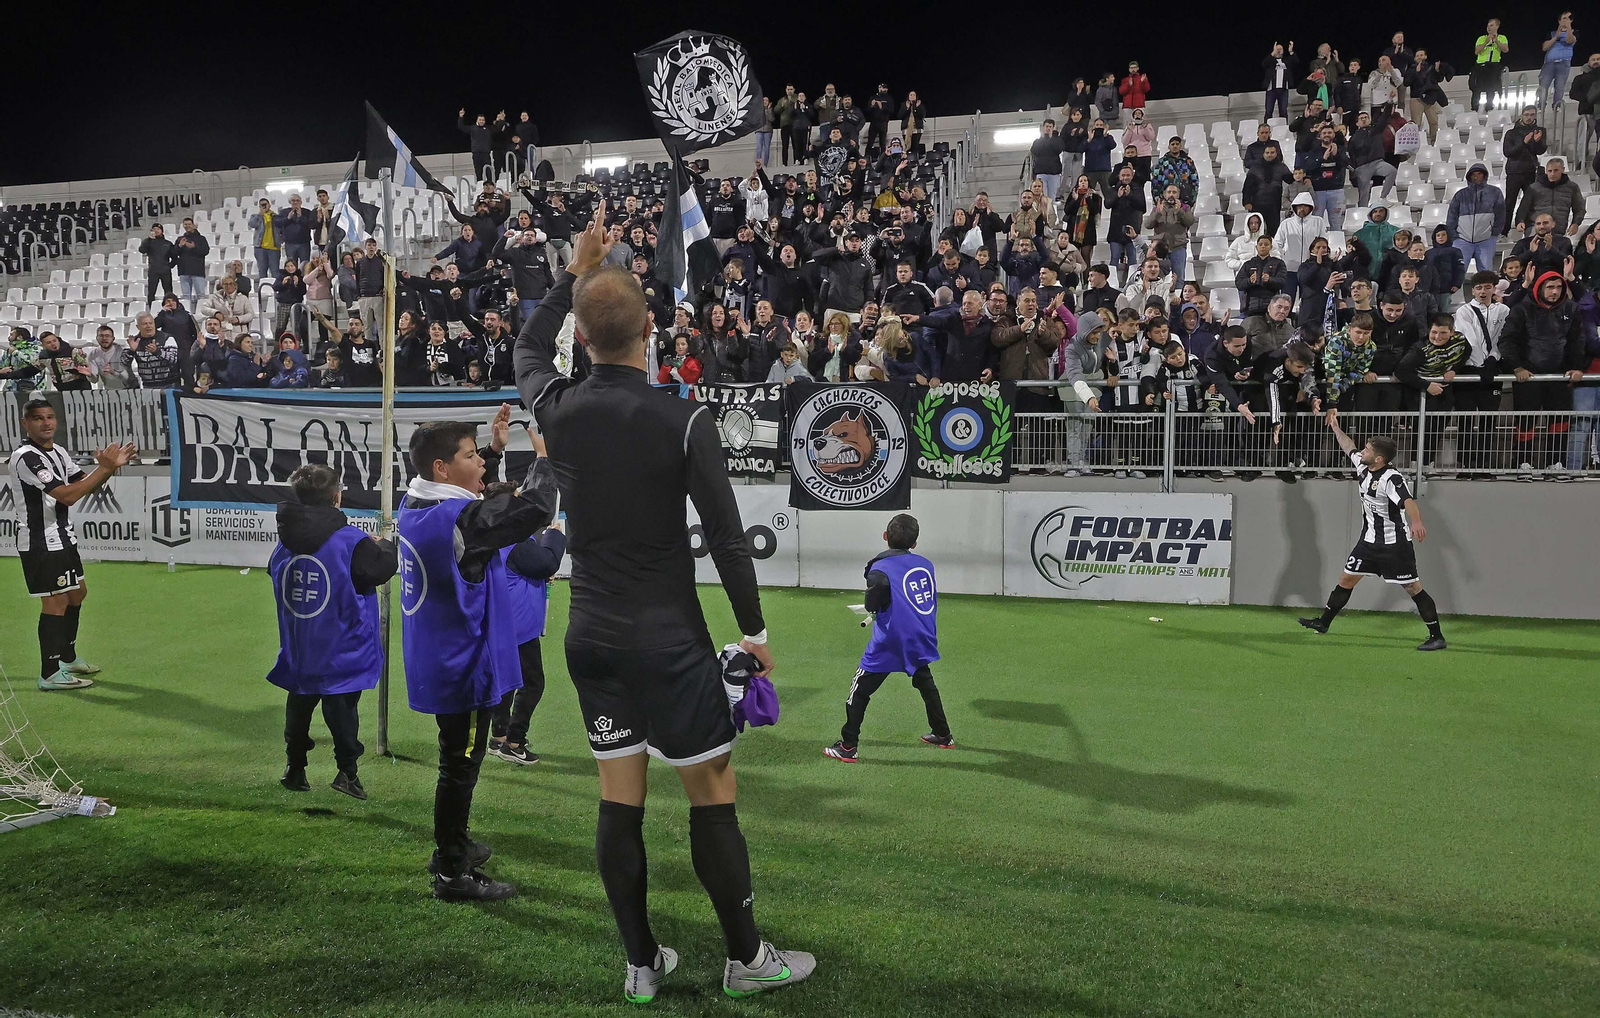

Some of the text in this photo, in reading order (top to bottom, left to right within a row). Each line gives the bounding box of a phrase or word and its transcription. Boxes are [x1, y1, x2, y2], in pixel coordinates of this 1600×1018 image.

[673, 58, 734, 111] REAL BALOMPEDICA
[697, 107, 737, 131] LINENSE
[693, 384, 781, 404] ULTRAS
[813, 389, 882, 413] CACHORROS
[62, 389, 167, 450] PRESIDENTE
[793, 438, 806, 450] 19
[891, 438, 906, 451] 12
[805, 472, 891, 502] COLECTIVODOCE
[206, 517, 264, 529] SERVICIOS Y
[206, 530, 278, 542] MANTENIMIENT
[1064, 540, 1208, 564] IMPACT
[1064, 562, 1126, 574] TRAINING
[1128, 565, 1176, 576] CAMPS
[1347, 556, 1362, 570] 21
[602, 728, 632, 741] Galán
